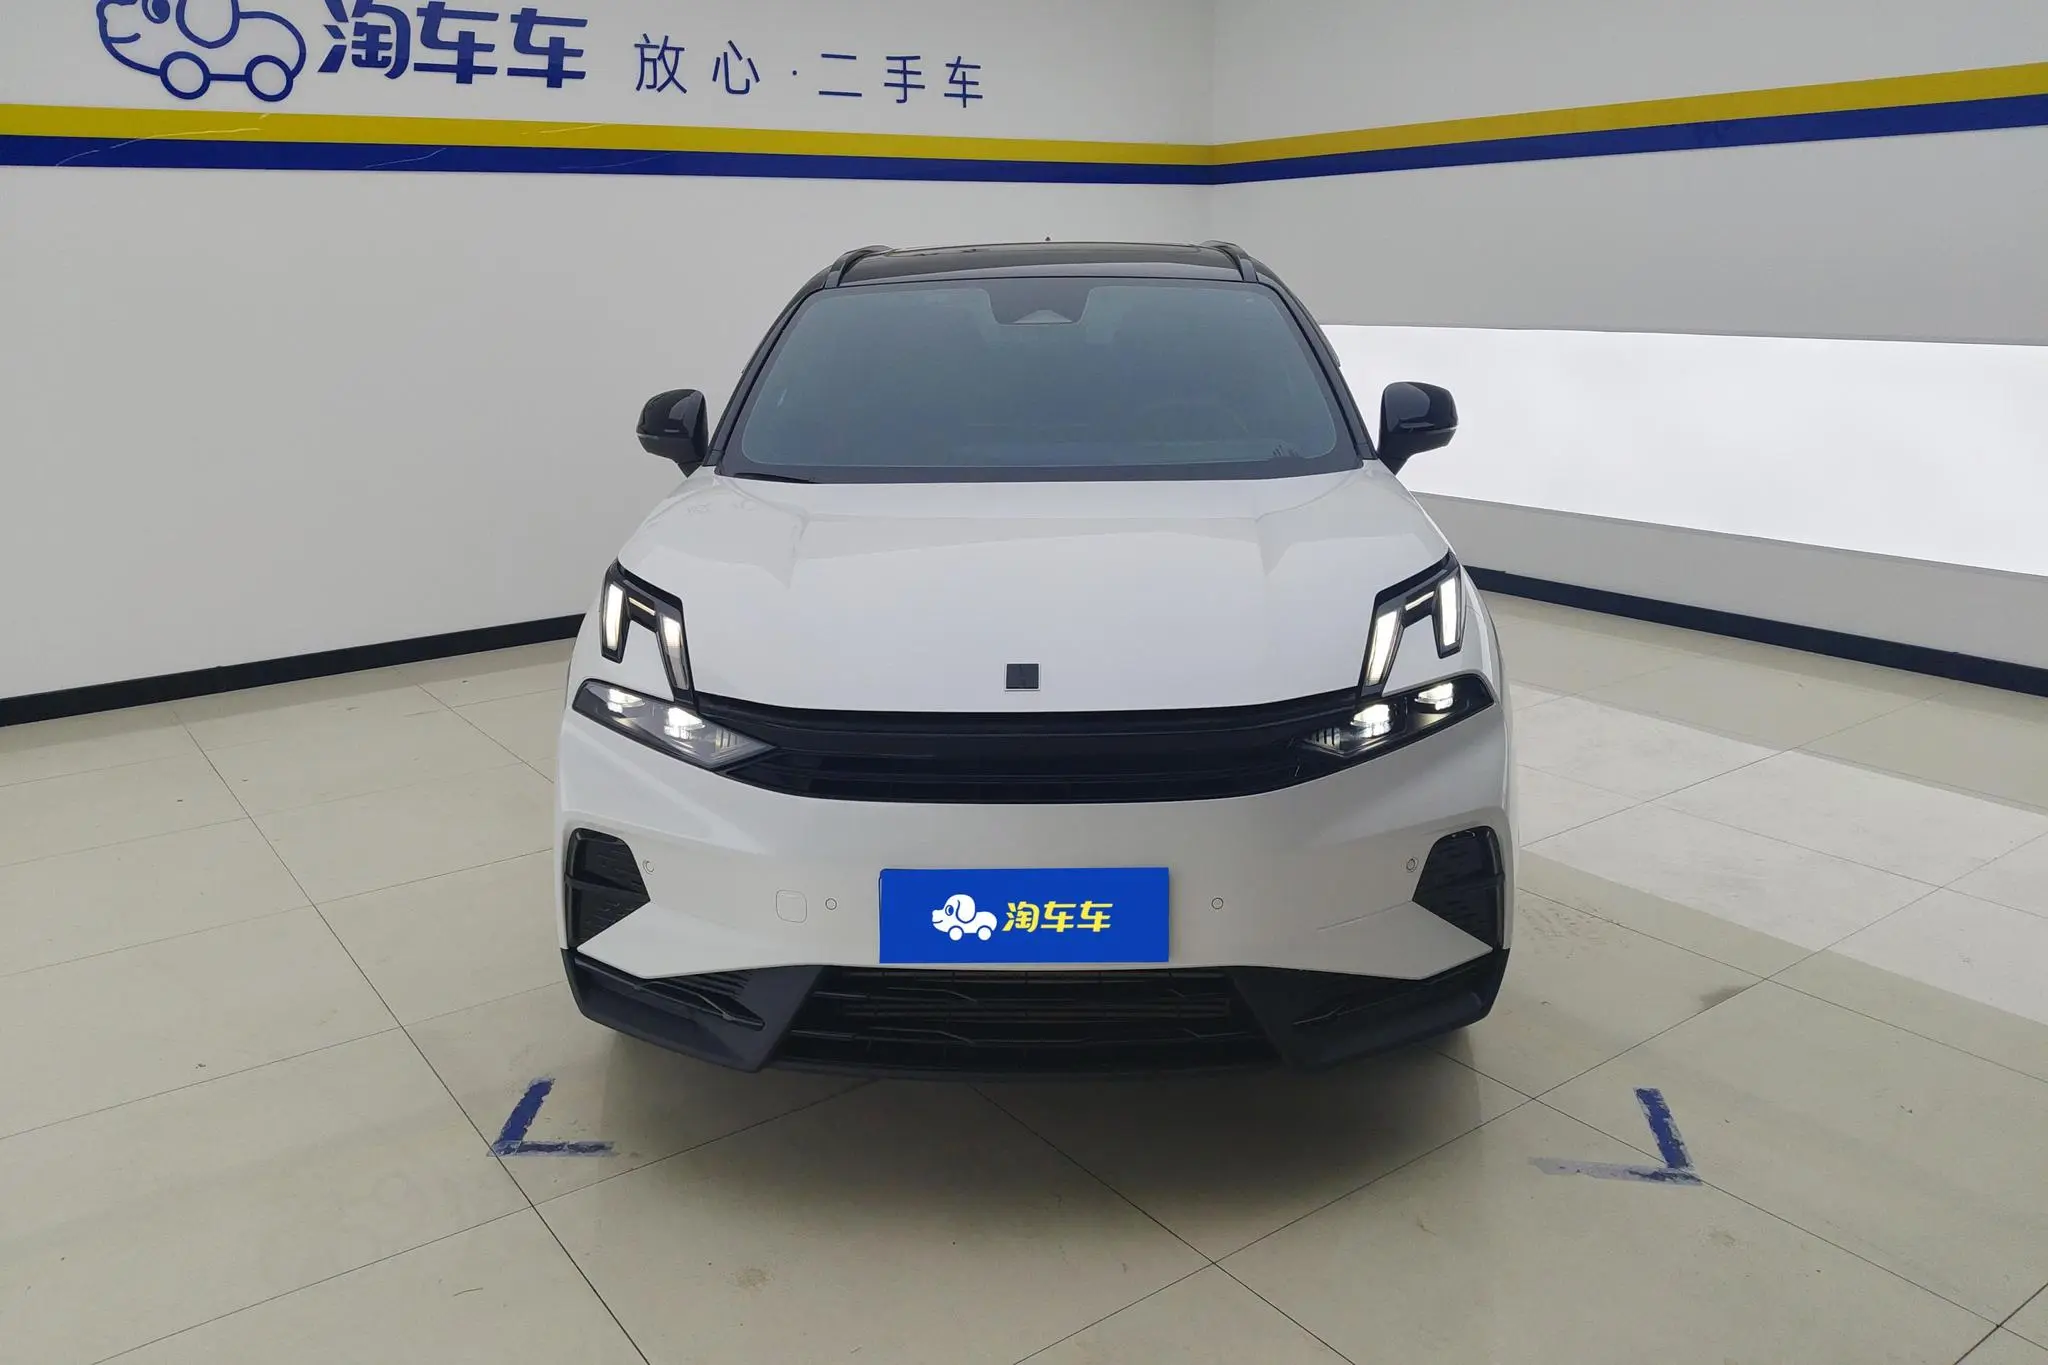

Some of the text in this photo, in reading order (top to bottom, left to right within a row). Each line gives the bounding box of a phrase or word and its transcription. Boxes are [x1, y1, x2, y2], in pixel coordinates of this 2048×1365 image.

[318, 0, 588, 88] 淘车车
[1002, 900, 1114, 933] 淘车车
